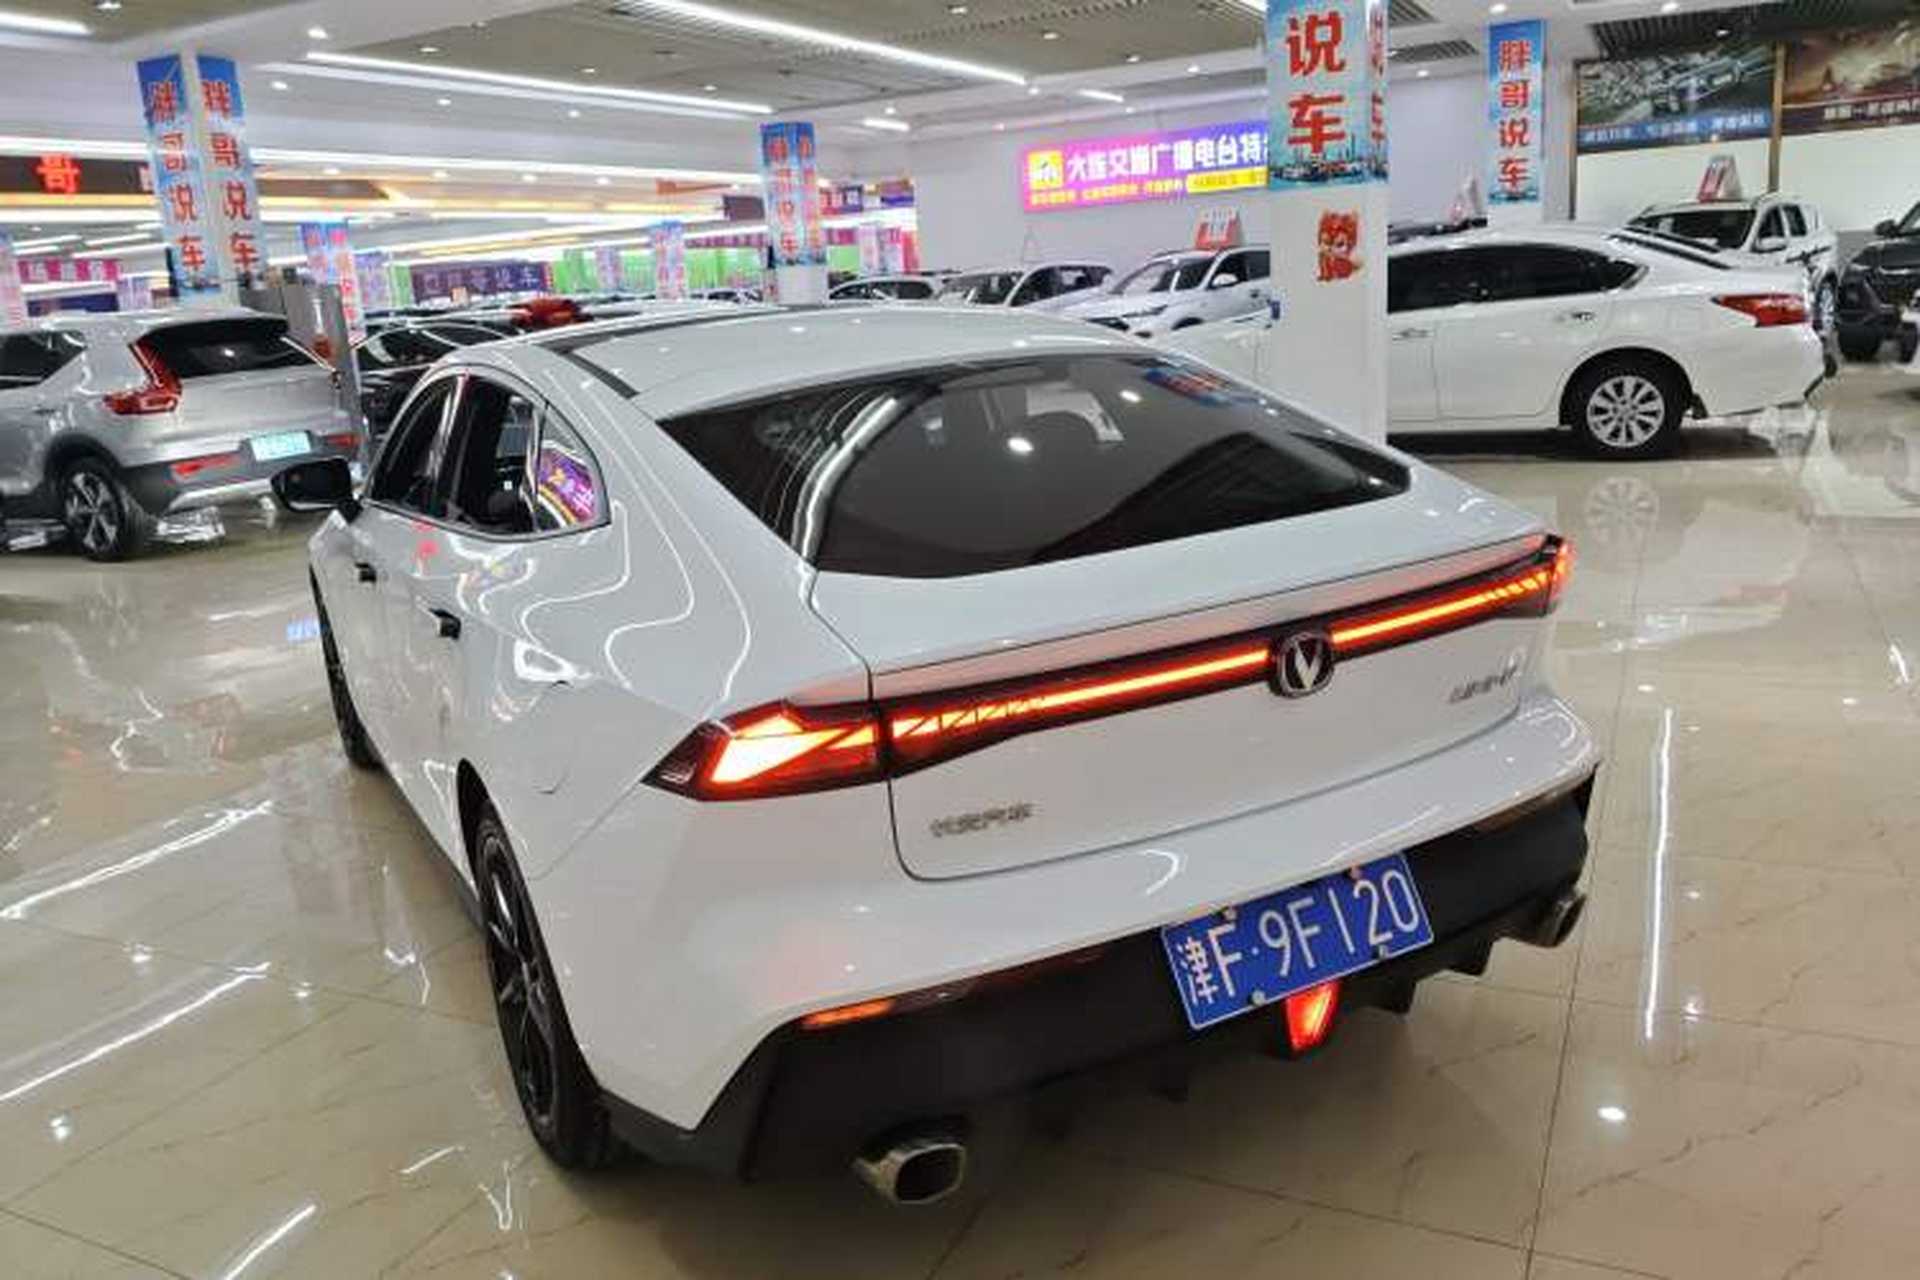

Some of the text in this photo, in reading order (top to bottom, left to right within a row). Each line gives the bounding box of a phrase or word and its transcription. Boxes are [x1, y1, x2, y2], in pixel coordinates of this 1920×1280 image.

[1286, 10, 1346, 155] 说车
[1498, 39, 1531, 192] 胖哥说车
[1067, 132, 1268, 182] 大连交通广播电台特
[1176, 869, 1420, 1005] 津F·9F120
